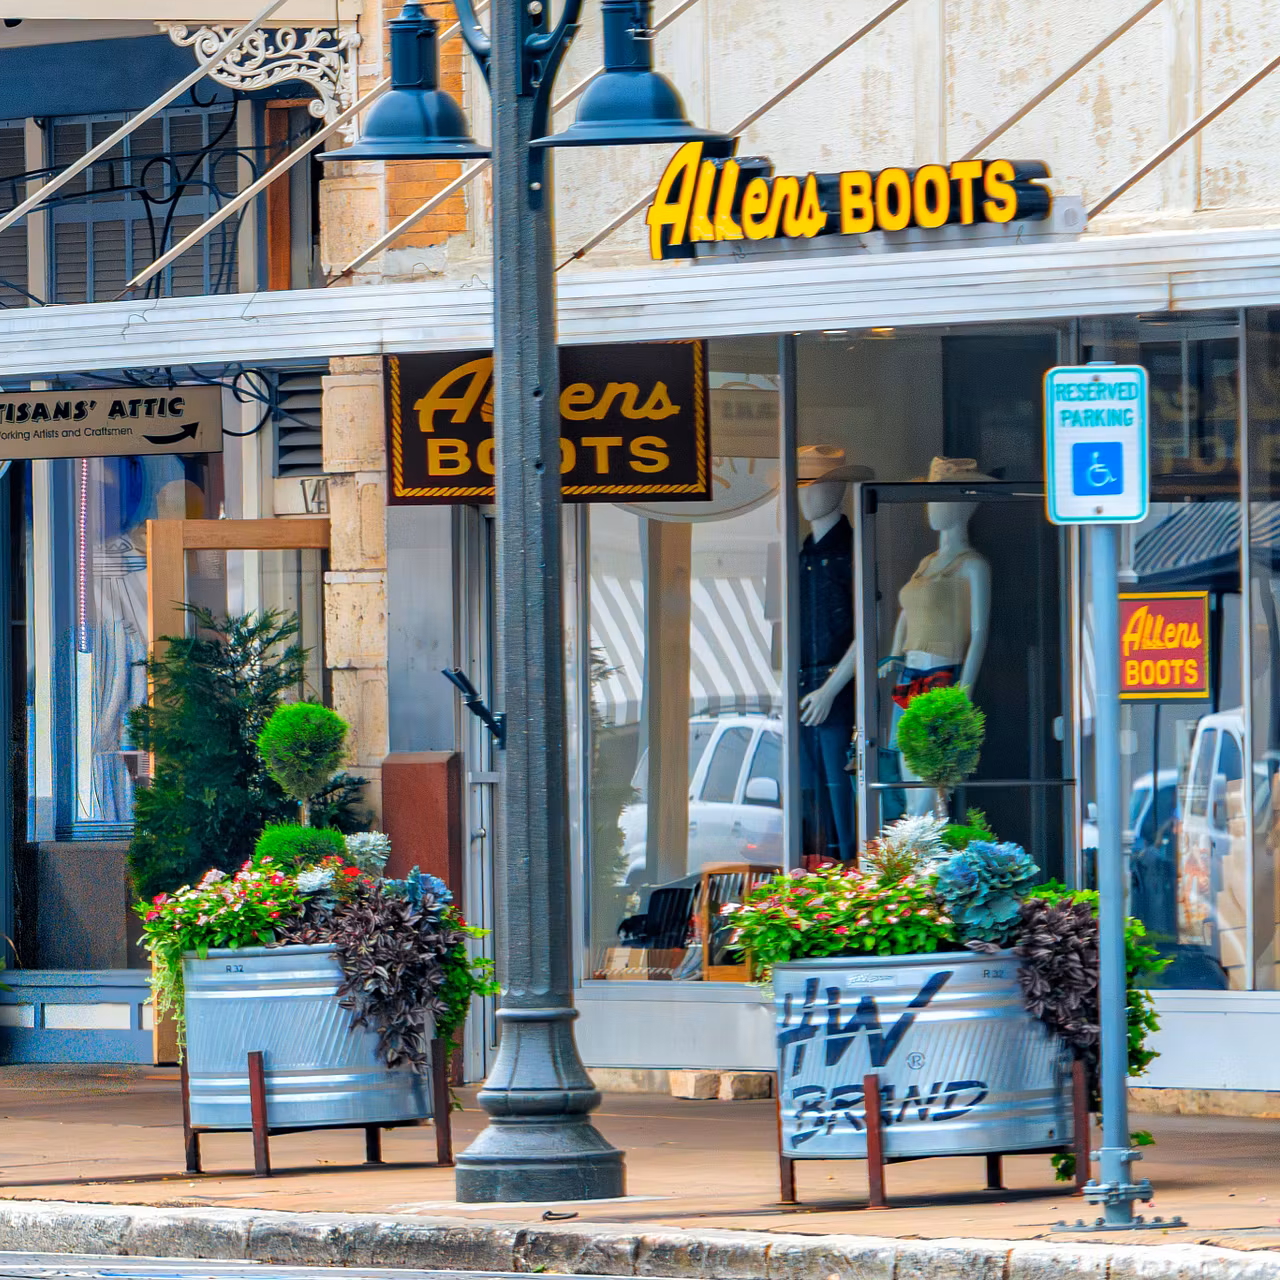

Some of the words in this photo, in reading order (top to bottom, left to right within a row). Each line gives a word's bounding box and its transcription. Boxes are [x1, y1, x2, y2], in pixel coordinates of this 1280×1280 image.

[646, 141, 828, 261] Allens
[841, 159, 1018, 235] BOOTS
[1056, 382, 1138, 401] RESERVED
[108, 397, 185, 419] ATTIC
[1060, 408, 1134, 427] PARKING
[33, 428, 59, 439] Artists
[62, 427, 81, 438] and
[84, 426, 133, 437] Craftsmen
[1122, 605, 1202, 657] Allens
[1126, 659, 1199, 686] BOOTS
